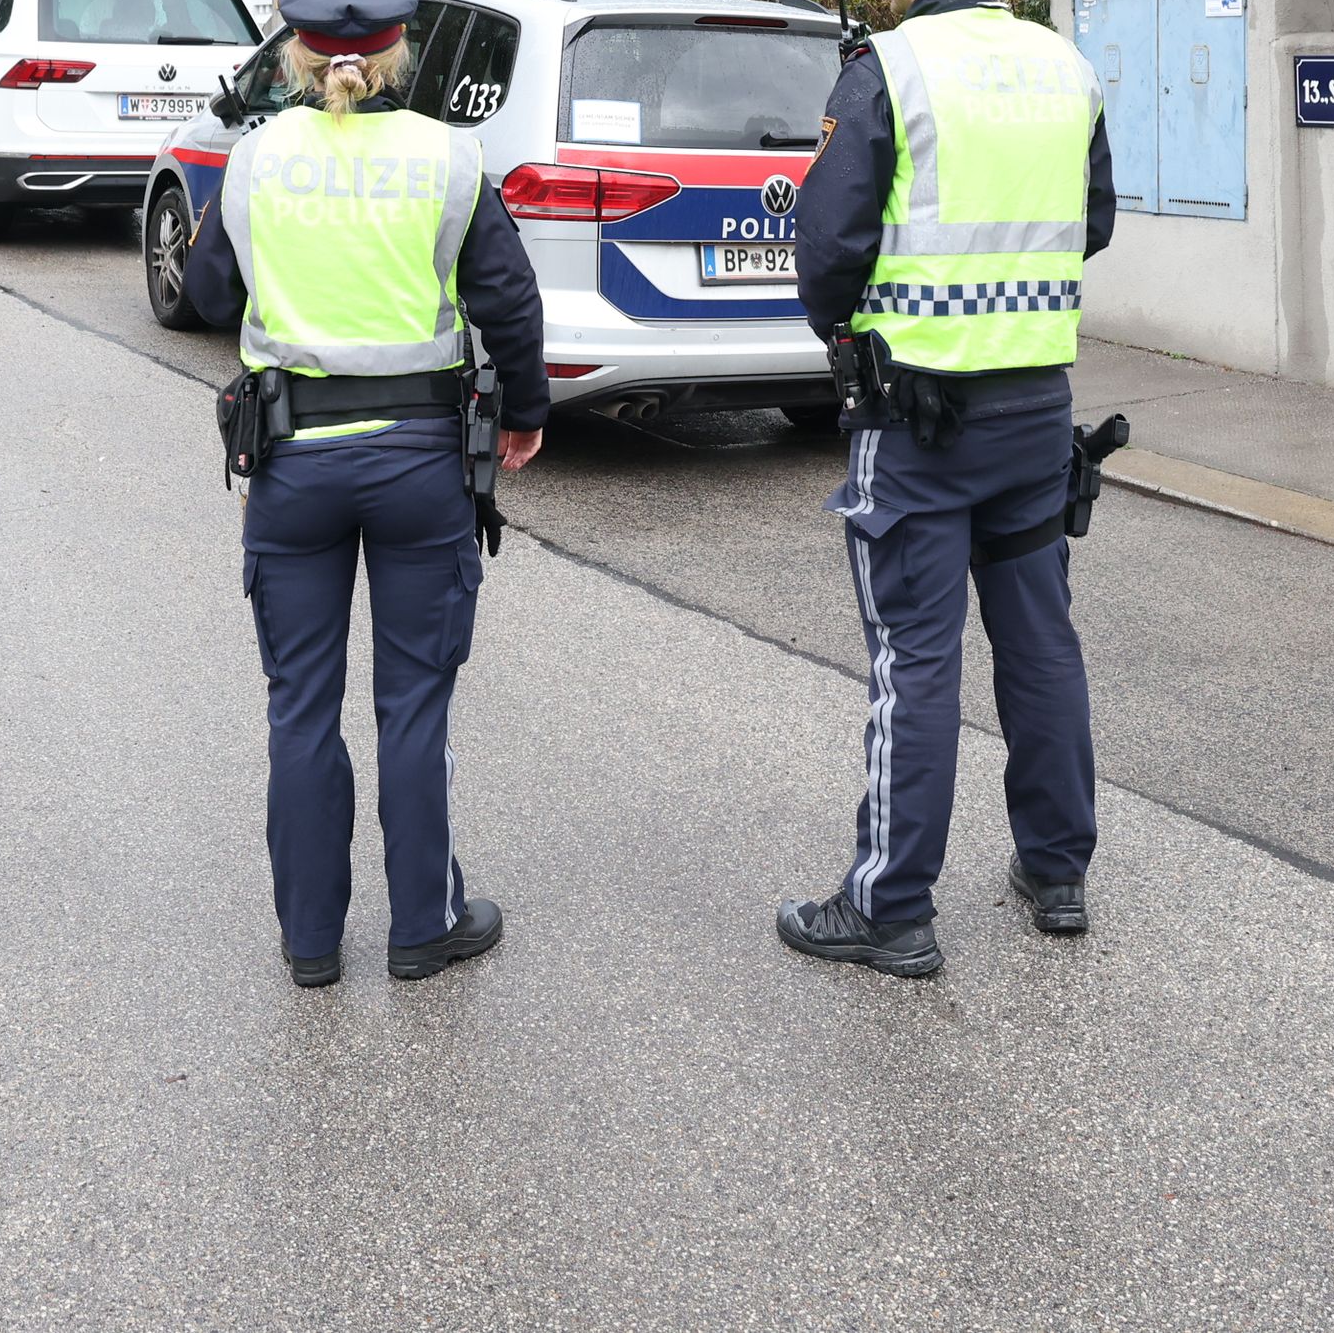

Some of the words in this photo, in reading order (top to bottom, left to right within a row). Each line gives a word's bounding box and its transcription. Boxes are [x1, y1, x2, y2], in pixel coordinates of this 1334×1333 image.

[130, 98, 140, 112] W
[466, 83, 502, 119] 133
[251, 154, 446, 200] POLIZEI
[724, 249, 748, 272] BP
